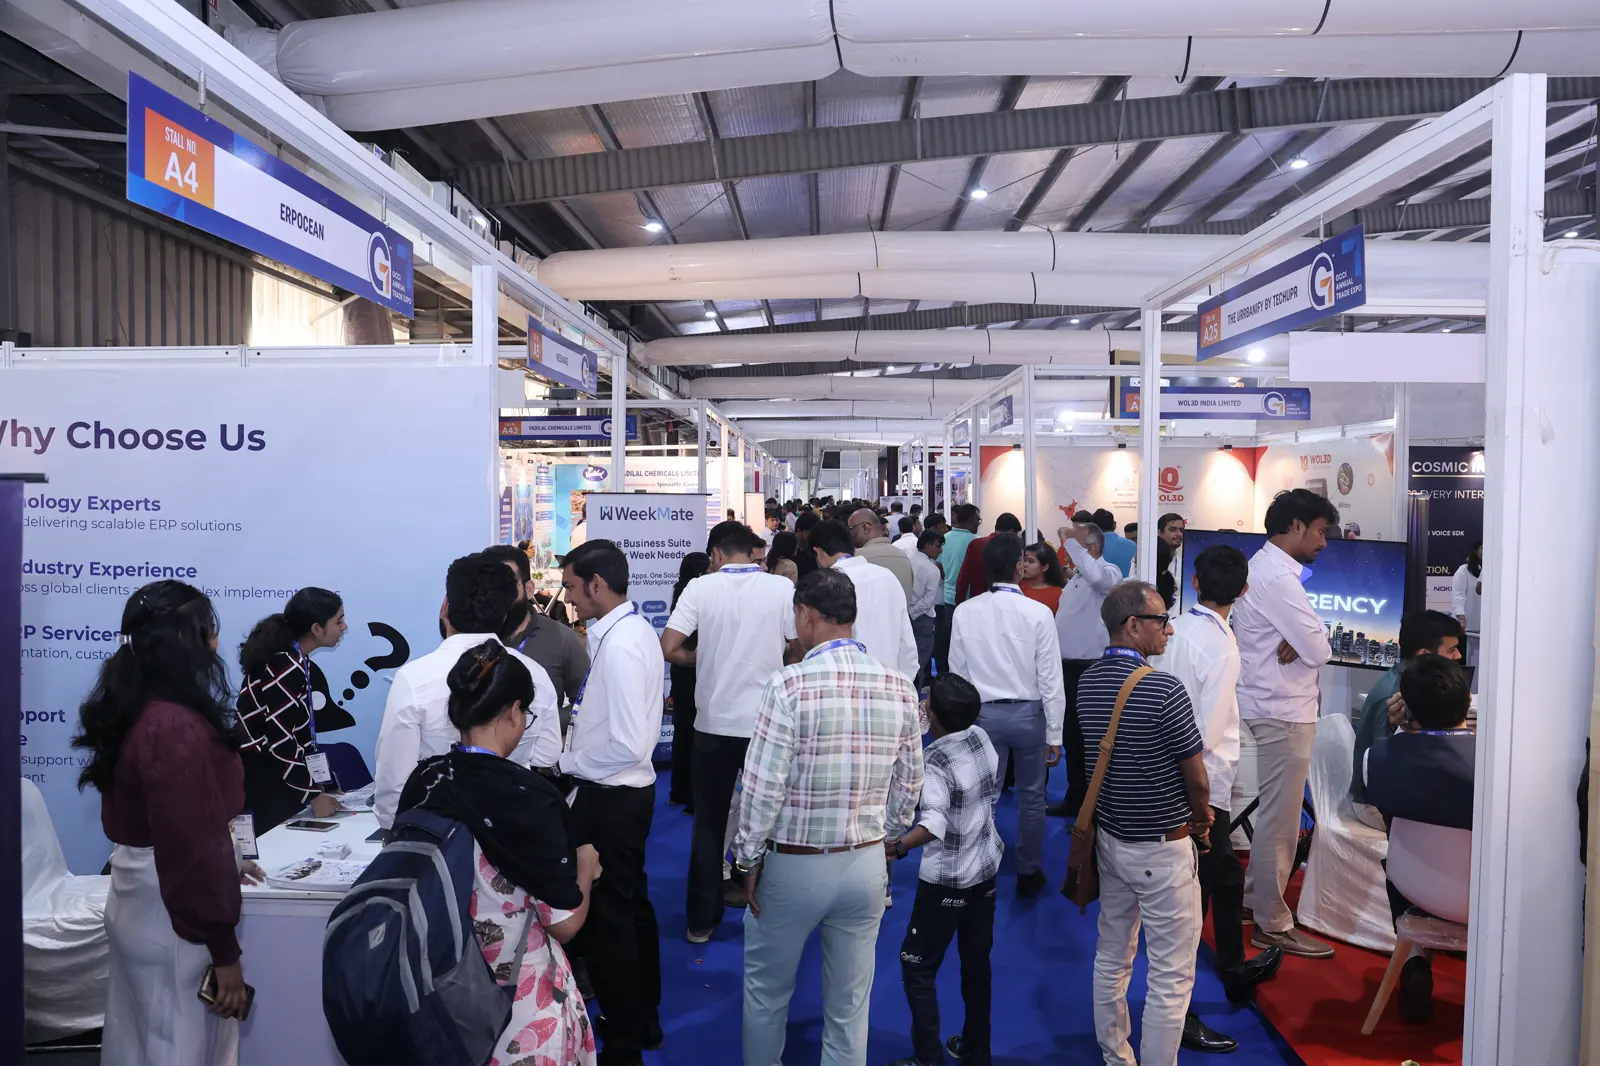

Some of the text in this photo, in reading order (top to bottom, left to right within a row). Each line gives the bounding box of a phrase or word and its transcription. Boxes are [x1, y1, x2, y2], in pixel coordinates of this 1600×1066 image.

[165, 126, 198, 156] STALL NO.
[164, 151, 198, 193] A4
[280, 203, 324, 241] ERPOCEAN
[1336, 289, 1350, 300] TRADE
[1228, 312, 1236, 325] THE
[1265, 297, 1272, 310] BY
[1203, 323, 1218, 343] A25
[66, 420, 207, 451] Choose
[219, 423, 266, 451] Us
[1412, 461, 1469, 473] COSMIC
[24, 493, 161, 514] ology Experts
[1158, 494, 1184, 502] OL3D
[615, 506, 694, 521] WeekMate
[24, 515, 242, 532] delivering scalable ERP solutions
[623, 539, 666, 548] Business
[668, 539, 691, 548] Suite
[629, 551, 656, 560] Week
[657, 551, 686, 560] Needs
[89, 561, 197, 580] Experience
[41, 582, 82, 595] global
[86, 582, 130, 595] clients
[21, 755, 75, 767] support
